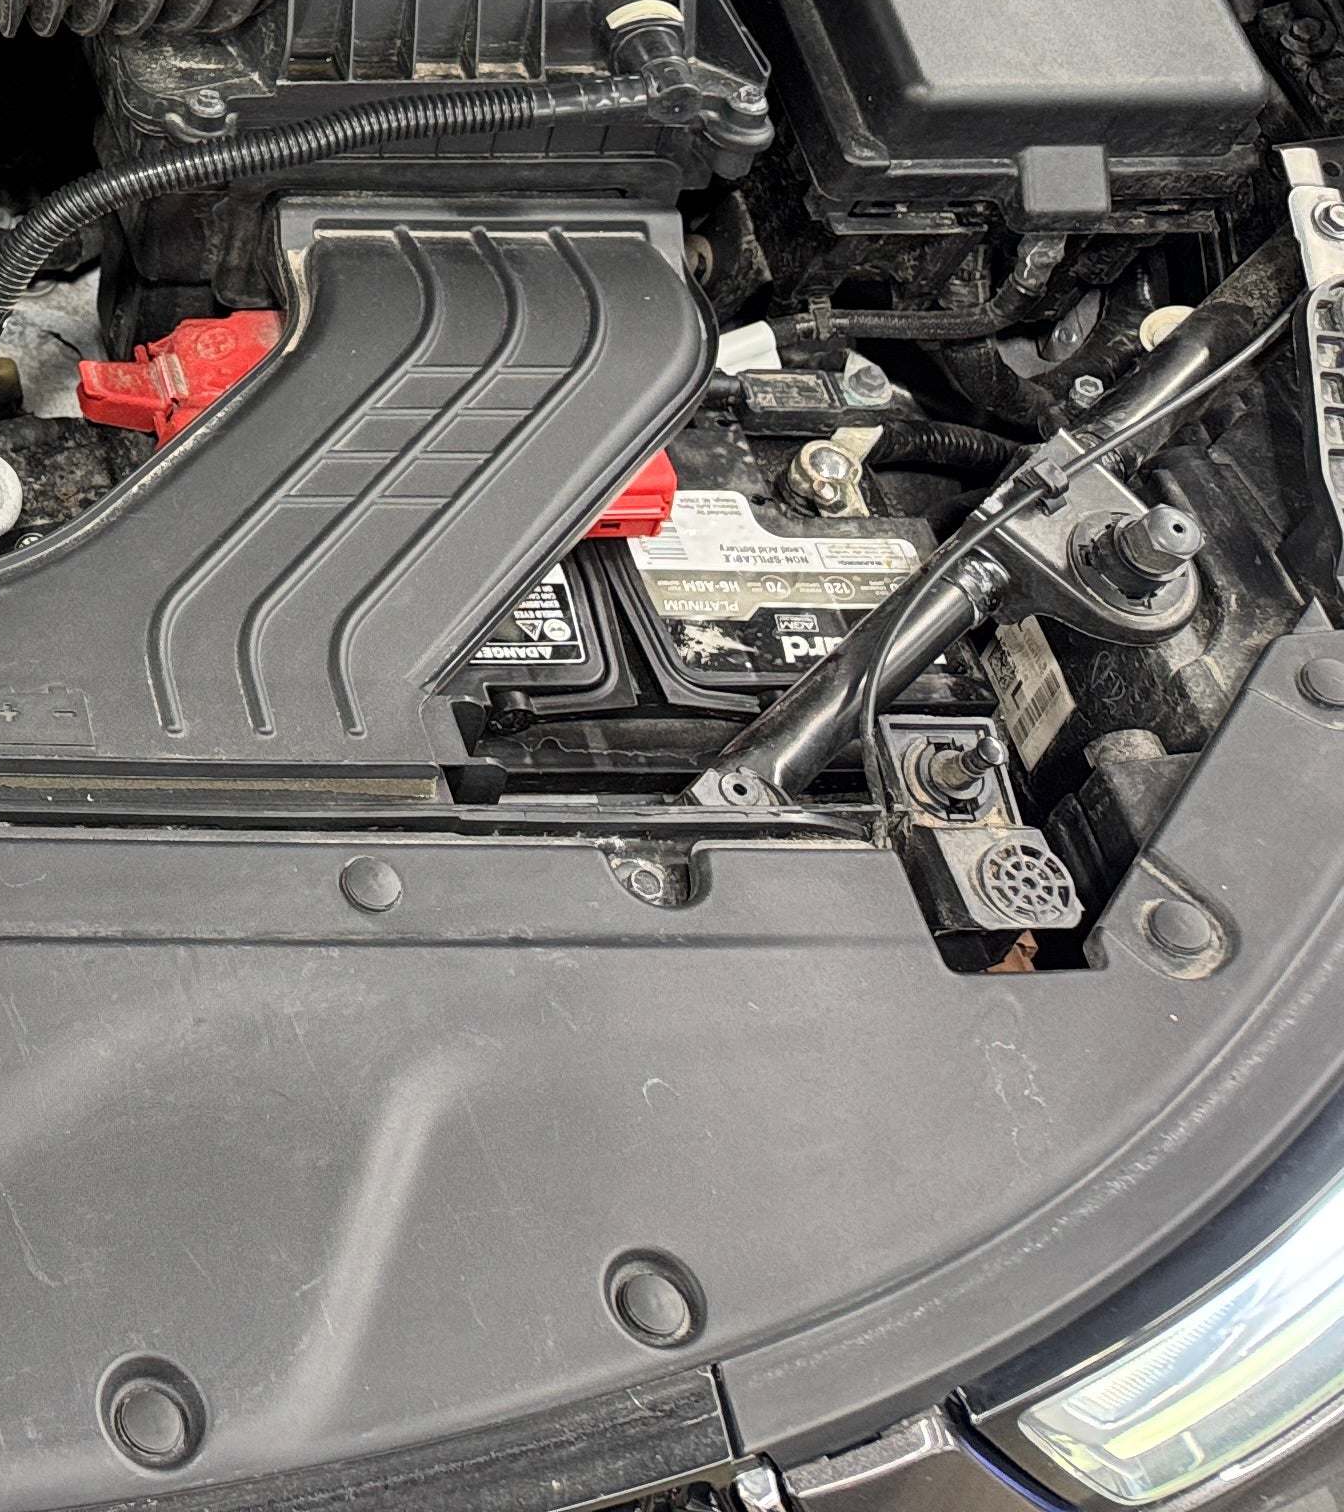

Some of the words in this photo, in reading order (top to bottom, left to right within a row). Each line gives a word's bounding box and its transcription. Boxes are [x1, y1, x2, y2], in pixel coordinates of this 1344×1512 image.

[765, 581, 785, 593] 70
[823, 582, 851, 594] 120
[663, 599, 739, 612] PLATINUM
[780, 621, 814, 630] AGM
